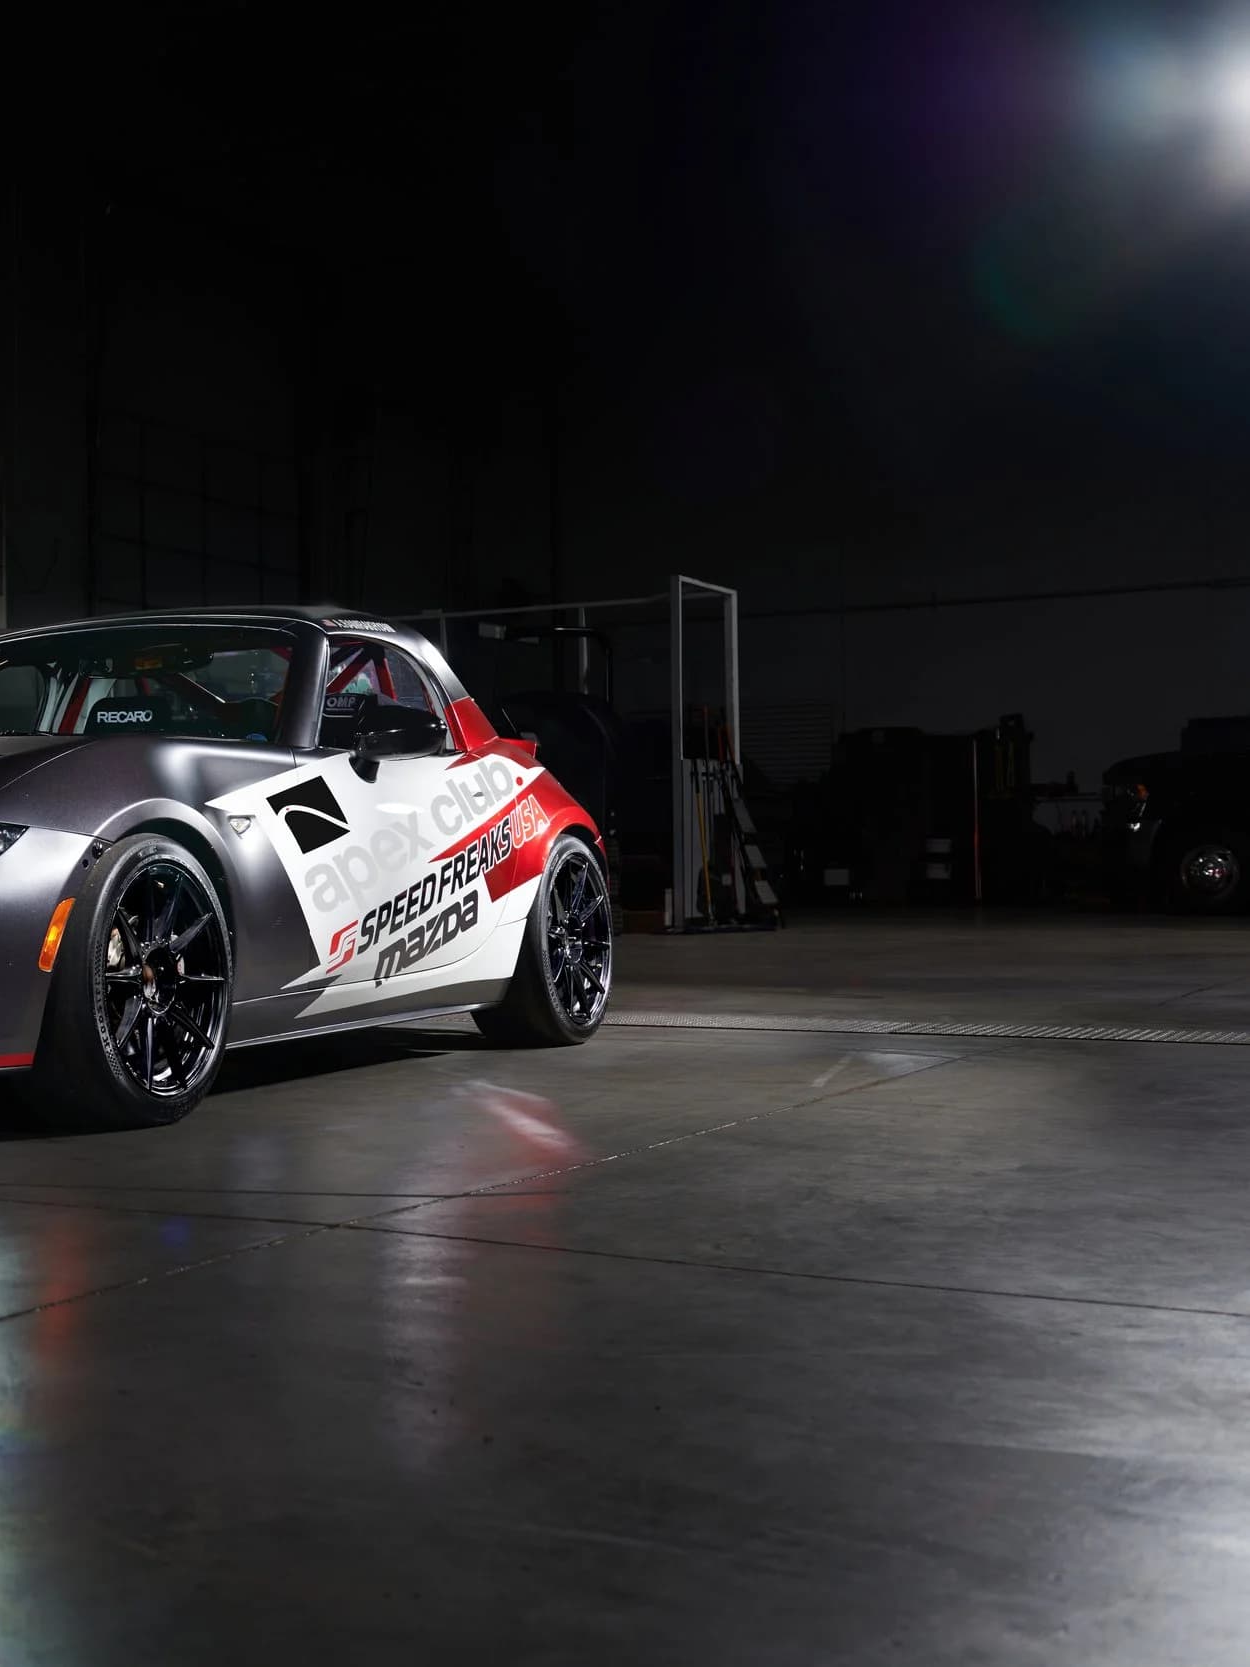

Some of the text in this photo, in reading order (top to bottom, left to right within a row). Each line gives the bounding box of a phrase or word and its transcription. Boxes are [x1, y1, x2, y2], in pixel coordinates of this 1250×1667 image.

[96, 709, 153, 724] RECARO
[326, 696, 356, 708] OMP
[509, 793, 551, 850] USA
[304, 810, 436, 916] apex
